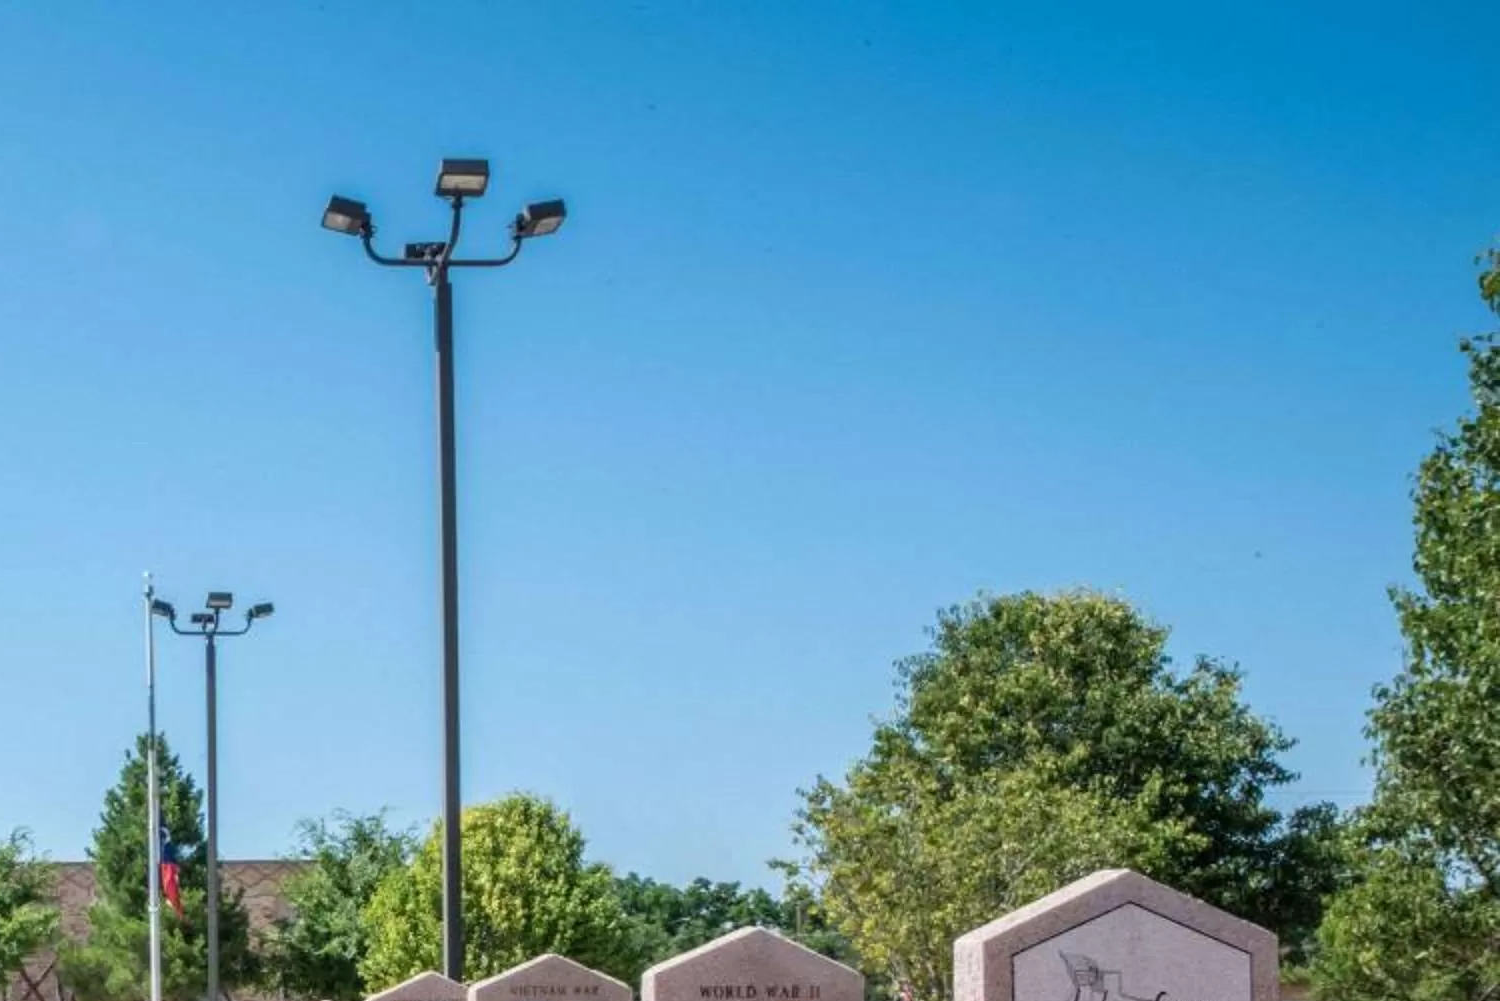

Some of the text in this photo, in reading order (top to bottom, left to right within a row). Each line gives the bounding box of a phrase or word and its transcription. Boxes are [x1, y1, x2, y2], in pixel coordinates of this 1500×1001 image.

[510, 984, 599, 996] VIETNAM WAR
[699, 985, 821, 999] WORLD WAR II
